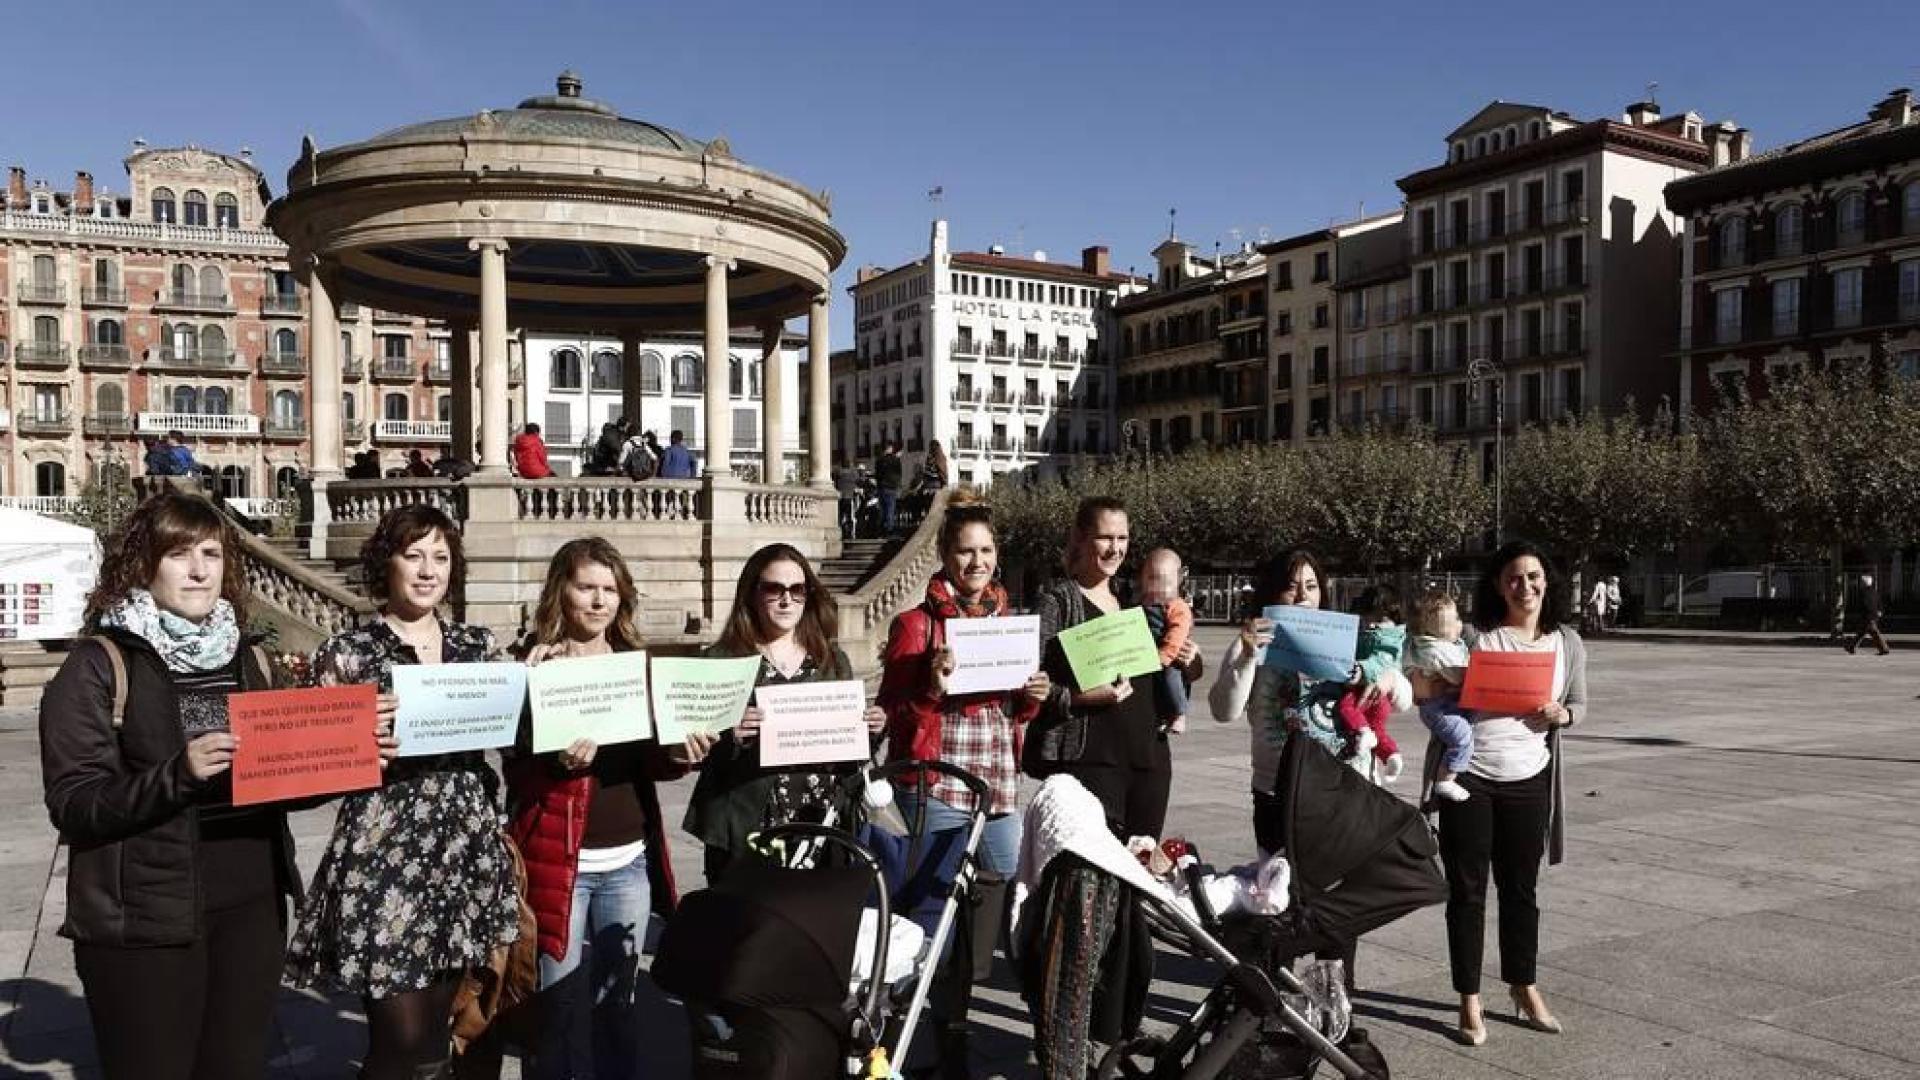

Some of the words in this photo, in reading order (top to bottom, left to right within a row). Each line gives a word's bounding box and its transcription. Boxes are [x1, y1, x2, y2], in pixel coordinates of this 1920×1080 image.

[952, 300, 1009, 319] HOTEL
[1018, 309, 1042, 322] LA
[1050, 310, 1098, 328] PERL
[279, 720, 294, 730] NO
